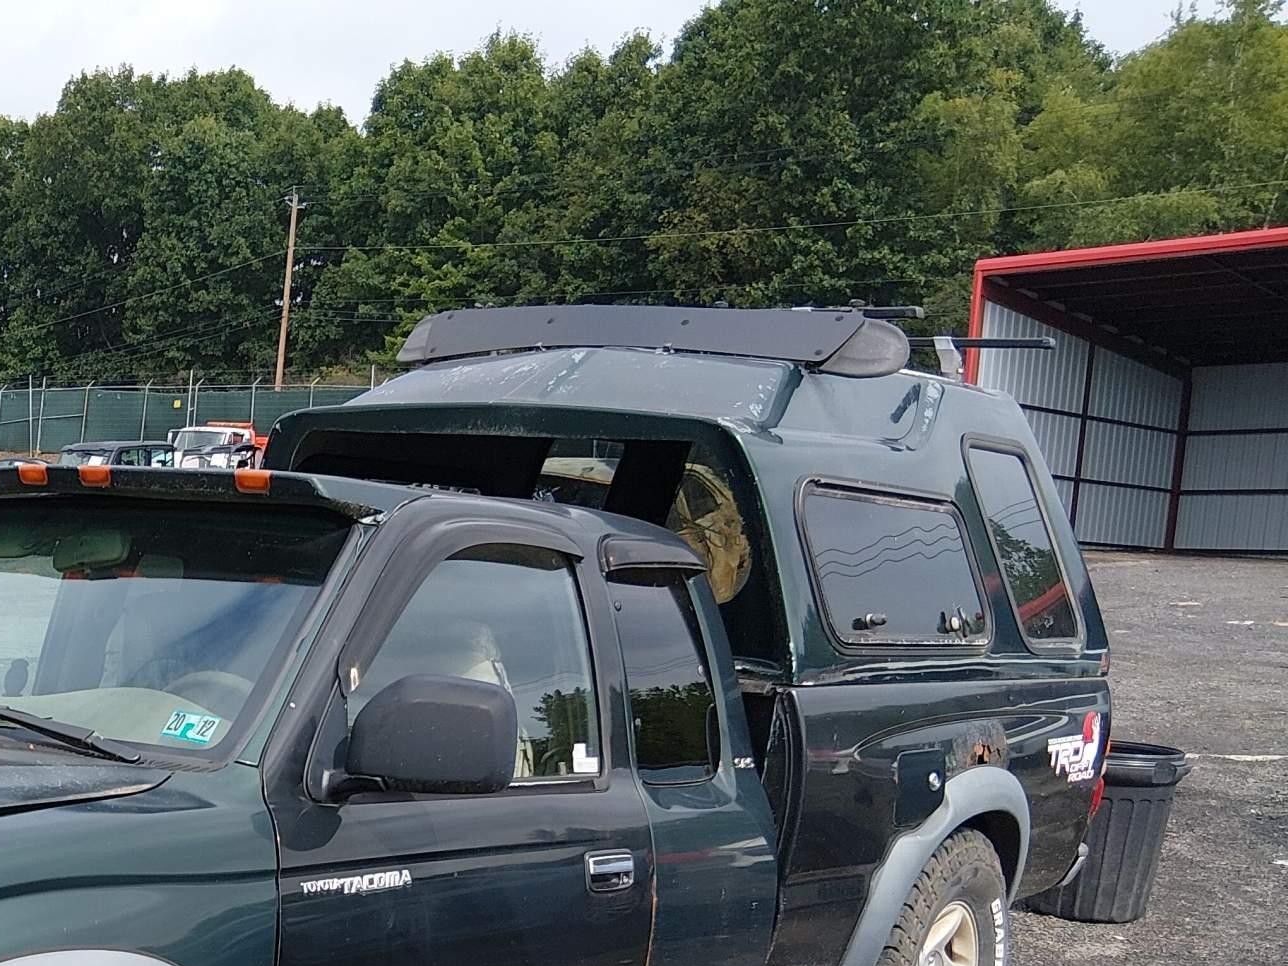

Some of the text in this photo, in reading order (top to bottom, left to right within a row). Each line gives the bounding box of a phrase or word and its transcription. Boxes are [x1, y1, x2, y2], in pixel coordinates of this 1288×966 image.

[166, 712, 216, 738] 20 12
[1048, 740, 1086, 777] TRD
[1067, 769, 1094, 783] ROAD
[300, 869, 412, 894] TOYOTA TACOMA
